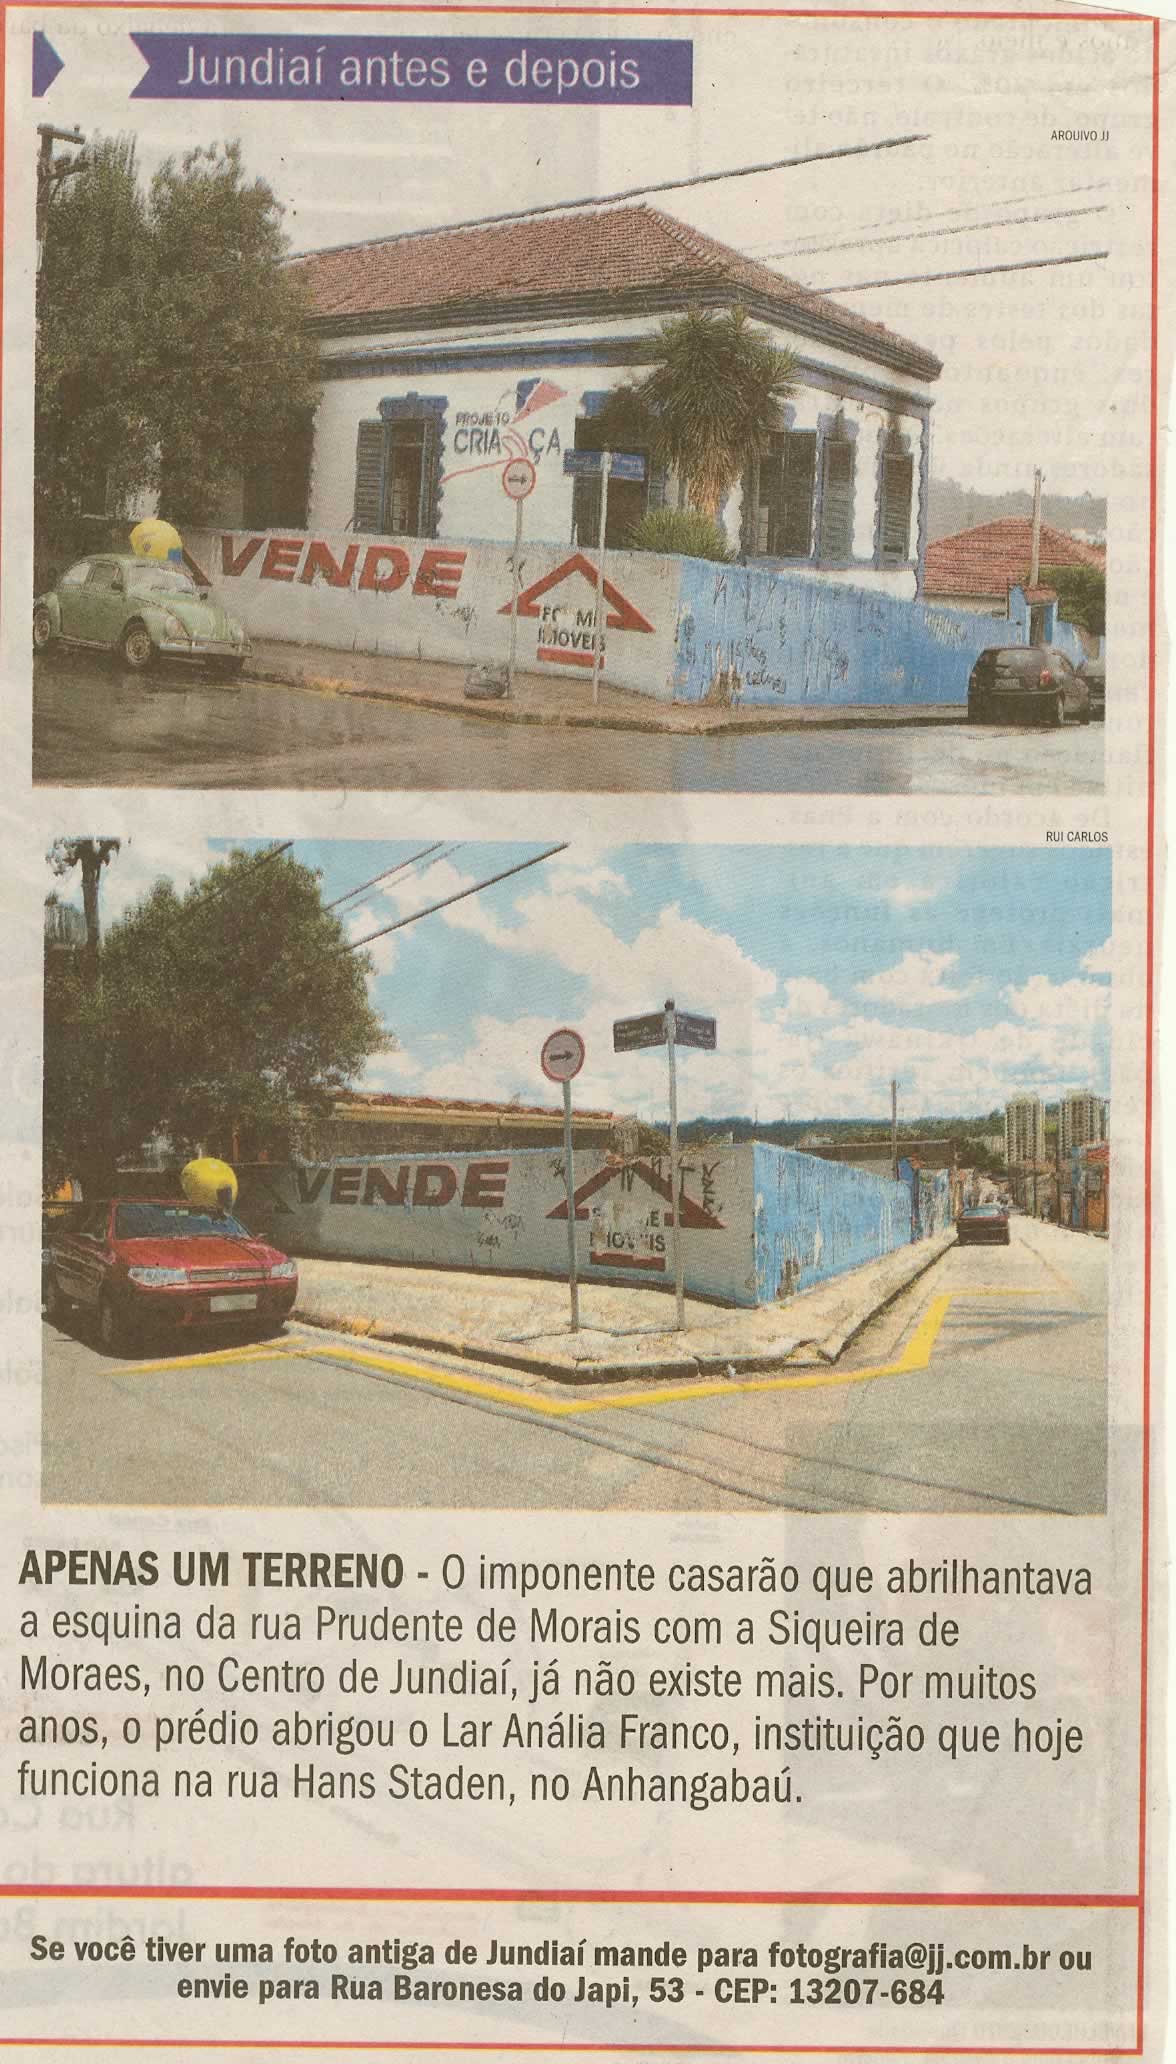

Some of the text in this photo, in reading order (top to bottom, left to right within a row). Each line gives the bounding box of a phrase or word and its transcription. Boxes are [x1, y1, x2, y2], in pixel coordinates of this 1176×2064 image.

[179, 47, 639, 94] Jundiaí antes e depois
[455, 410, 510, 427] PROJETO
[220, 534, 467, 599] VENDE
[1046, 831, 1109, 843] RUI CARLOS
[297, 1160, 511, 1209] VENDE
[18, 1549, 159, 1586] APENAS
[173, 1551, 229, 1587] UM
[242, 1552, 404, 1589] TERRENO
[442, 1553, 465, 1590] O
[480, 1554, 655, 1598] imponente
[668, 1556, 799, 1593] casarão
[812, 1566, 873, 1601] que
[887, 1558, 1092, 1596] abrilhantava
[20, 1604, 959, 1652] a esquina da rua Prudente de Morais com a Siqueira de
[21, 1655, 1037, 1704] Moraes, no Centro de Jundiaí, já não existe mais. Por muitos
[19, 1707, 1083, 1760] anos, o prédio abrigou o Lar Anália Franco, instituição que hoje
[17, 1760, 802, 1811] funciona na rua Hans Staden, no Anhangabaú.
[30, 1935, 1092, 1975] Se você tiver uma foto antiga de Jundiaí mande para fotografia@jj.com.br ou
[177, 1973, 249, 1999] envie
[259, 1979, 319, 2005] para
[331, 1974, 383, 2000] Rua
[394, 1974, 523, 2002] Baronesa
[533, 1976, 566, 2002] do
[574, 1976, 639, 2009] Japi,
[649, 1977, 684, 2003] 53
[714, 1977, 777, 2004] CEP:
[790, 1978, 945, 2005] 13207-684
